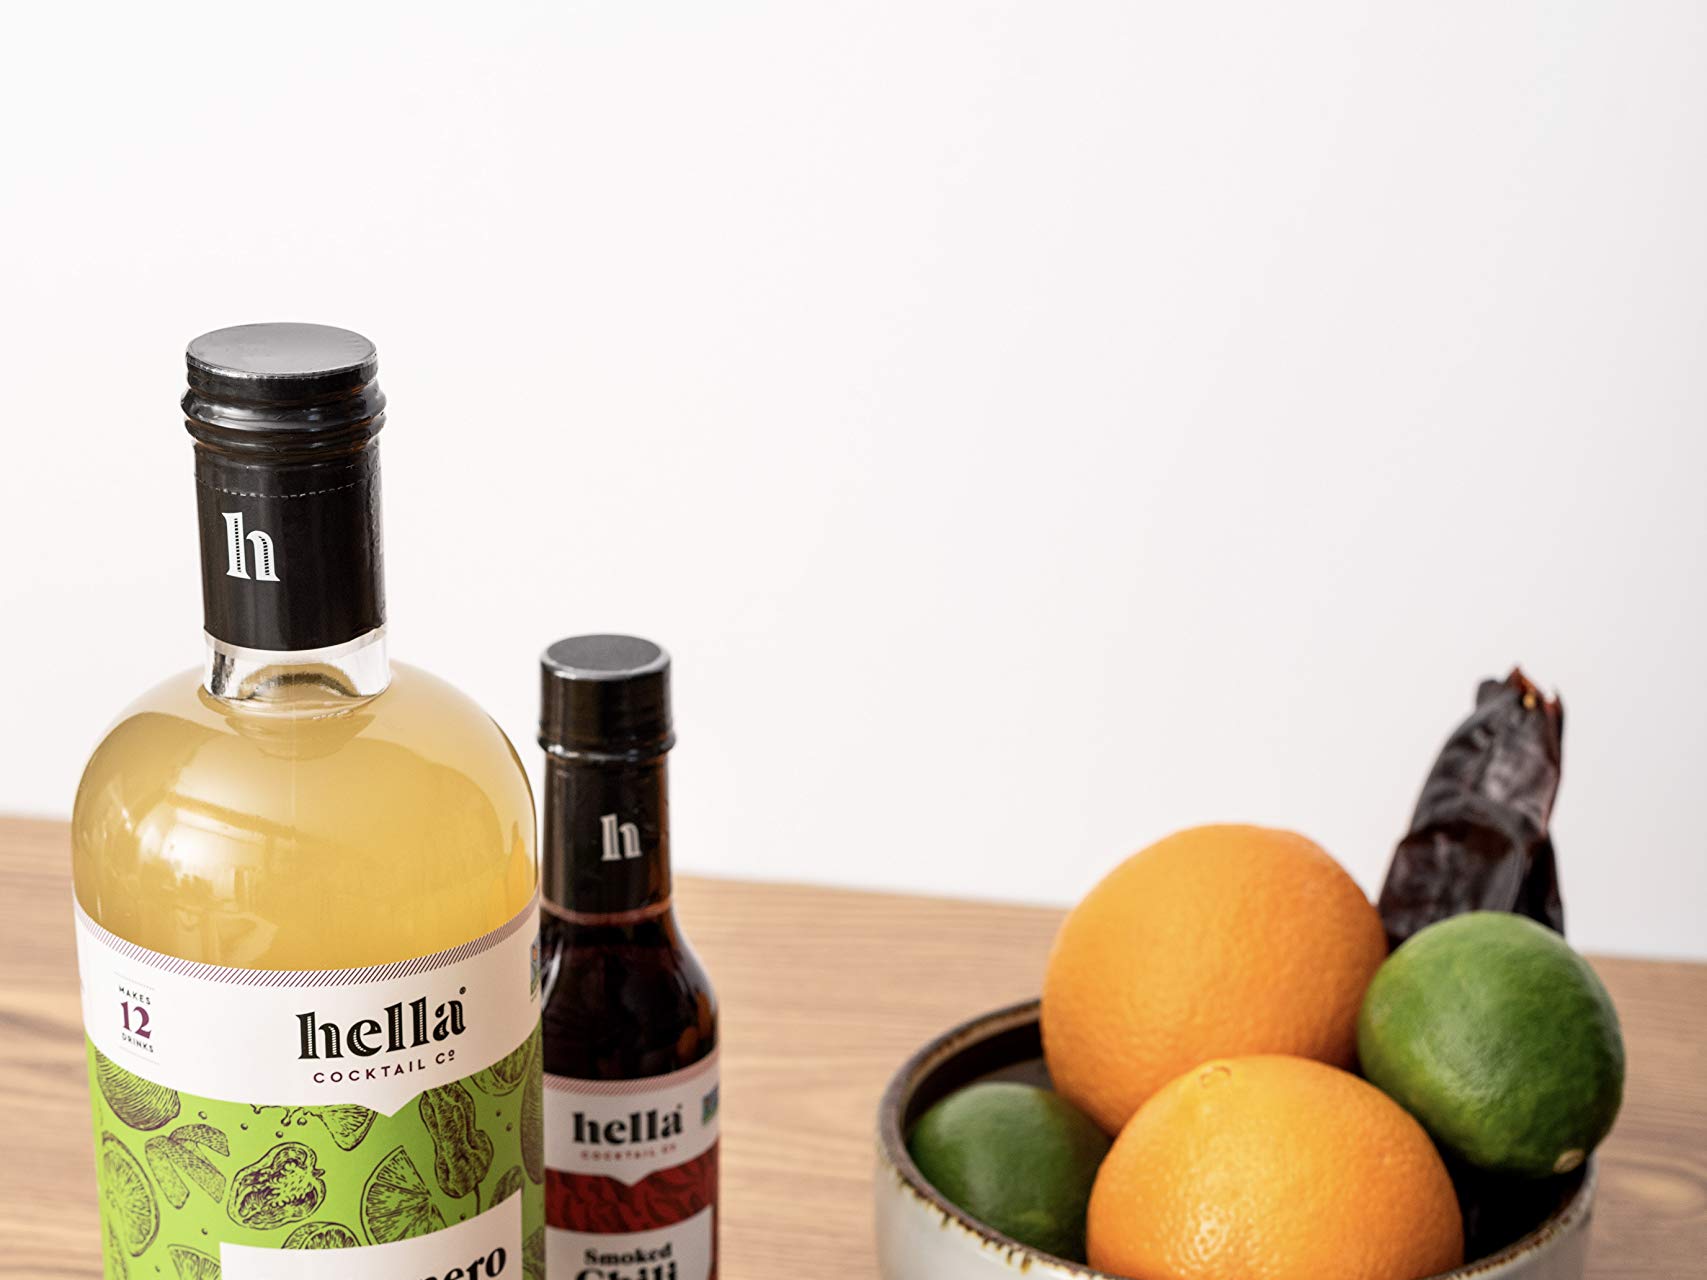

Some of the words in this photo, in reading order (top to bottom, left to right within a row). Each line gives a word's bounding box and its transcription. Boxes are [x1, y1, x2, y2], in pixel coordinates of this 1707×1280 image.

[222, 512, 281, 582] h
[601, 814, 642, 861] h
[119, 985, 151, 1005] MAKES
[120, 1001, 152, 1039] 12
[295, 996, 467, 1060] hella
[121, 1032, 154, 1053] DRINKS
[313, 1059, 426, 1084] COCKTAIL
[572, 1109, 683, 1145] hella
[584, 1242, 673, 1267] Smoked
